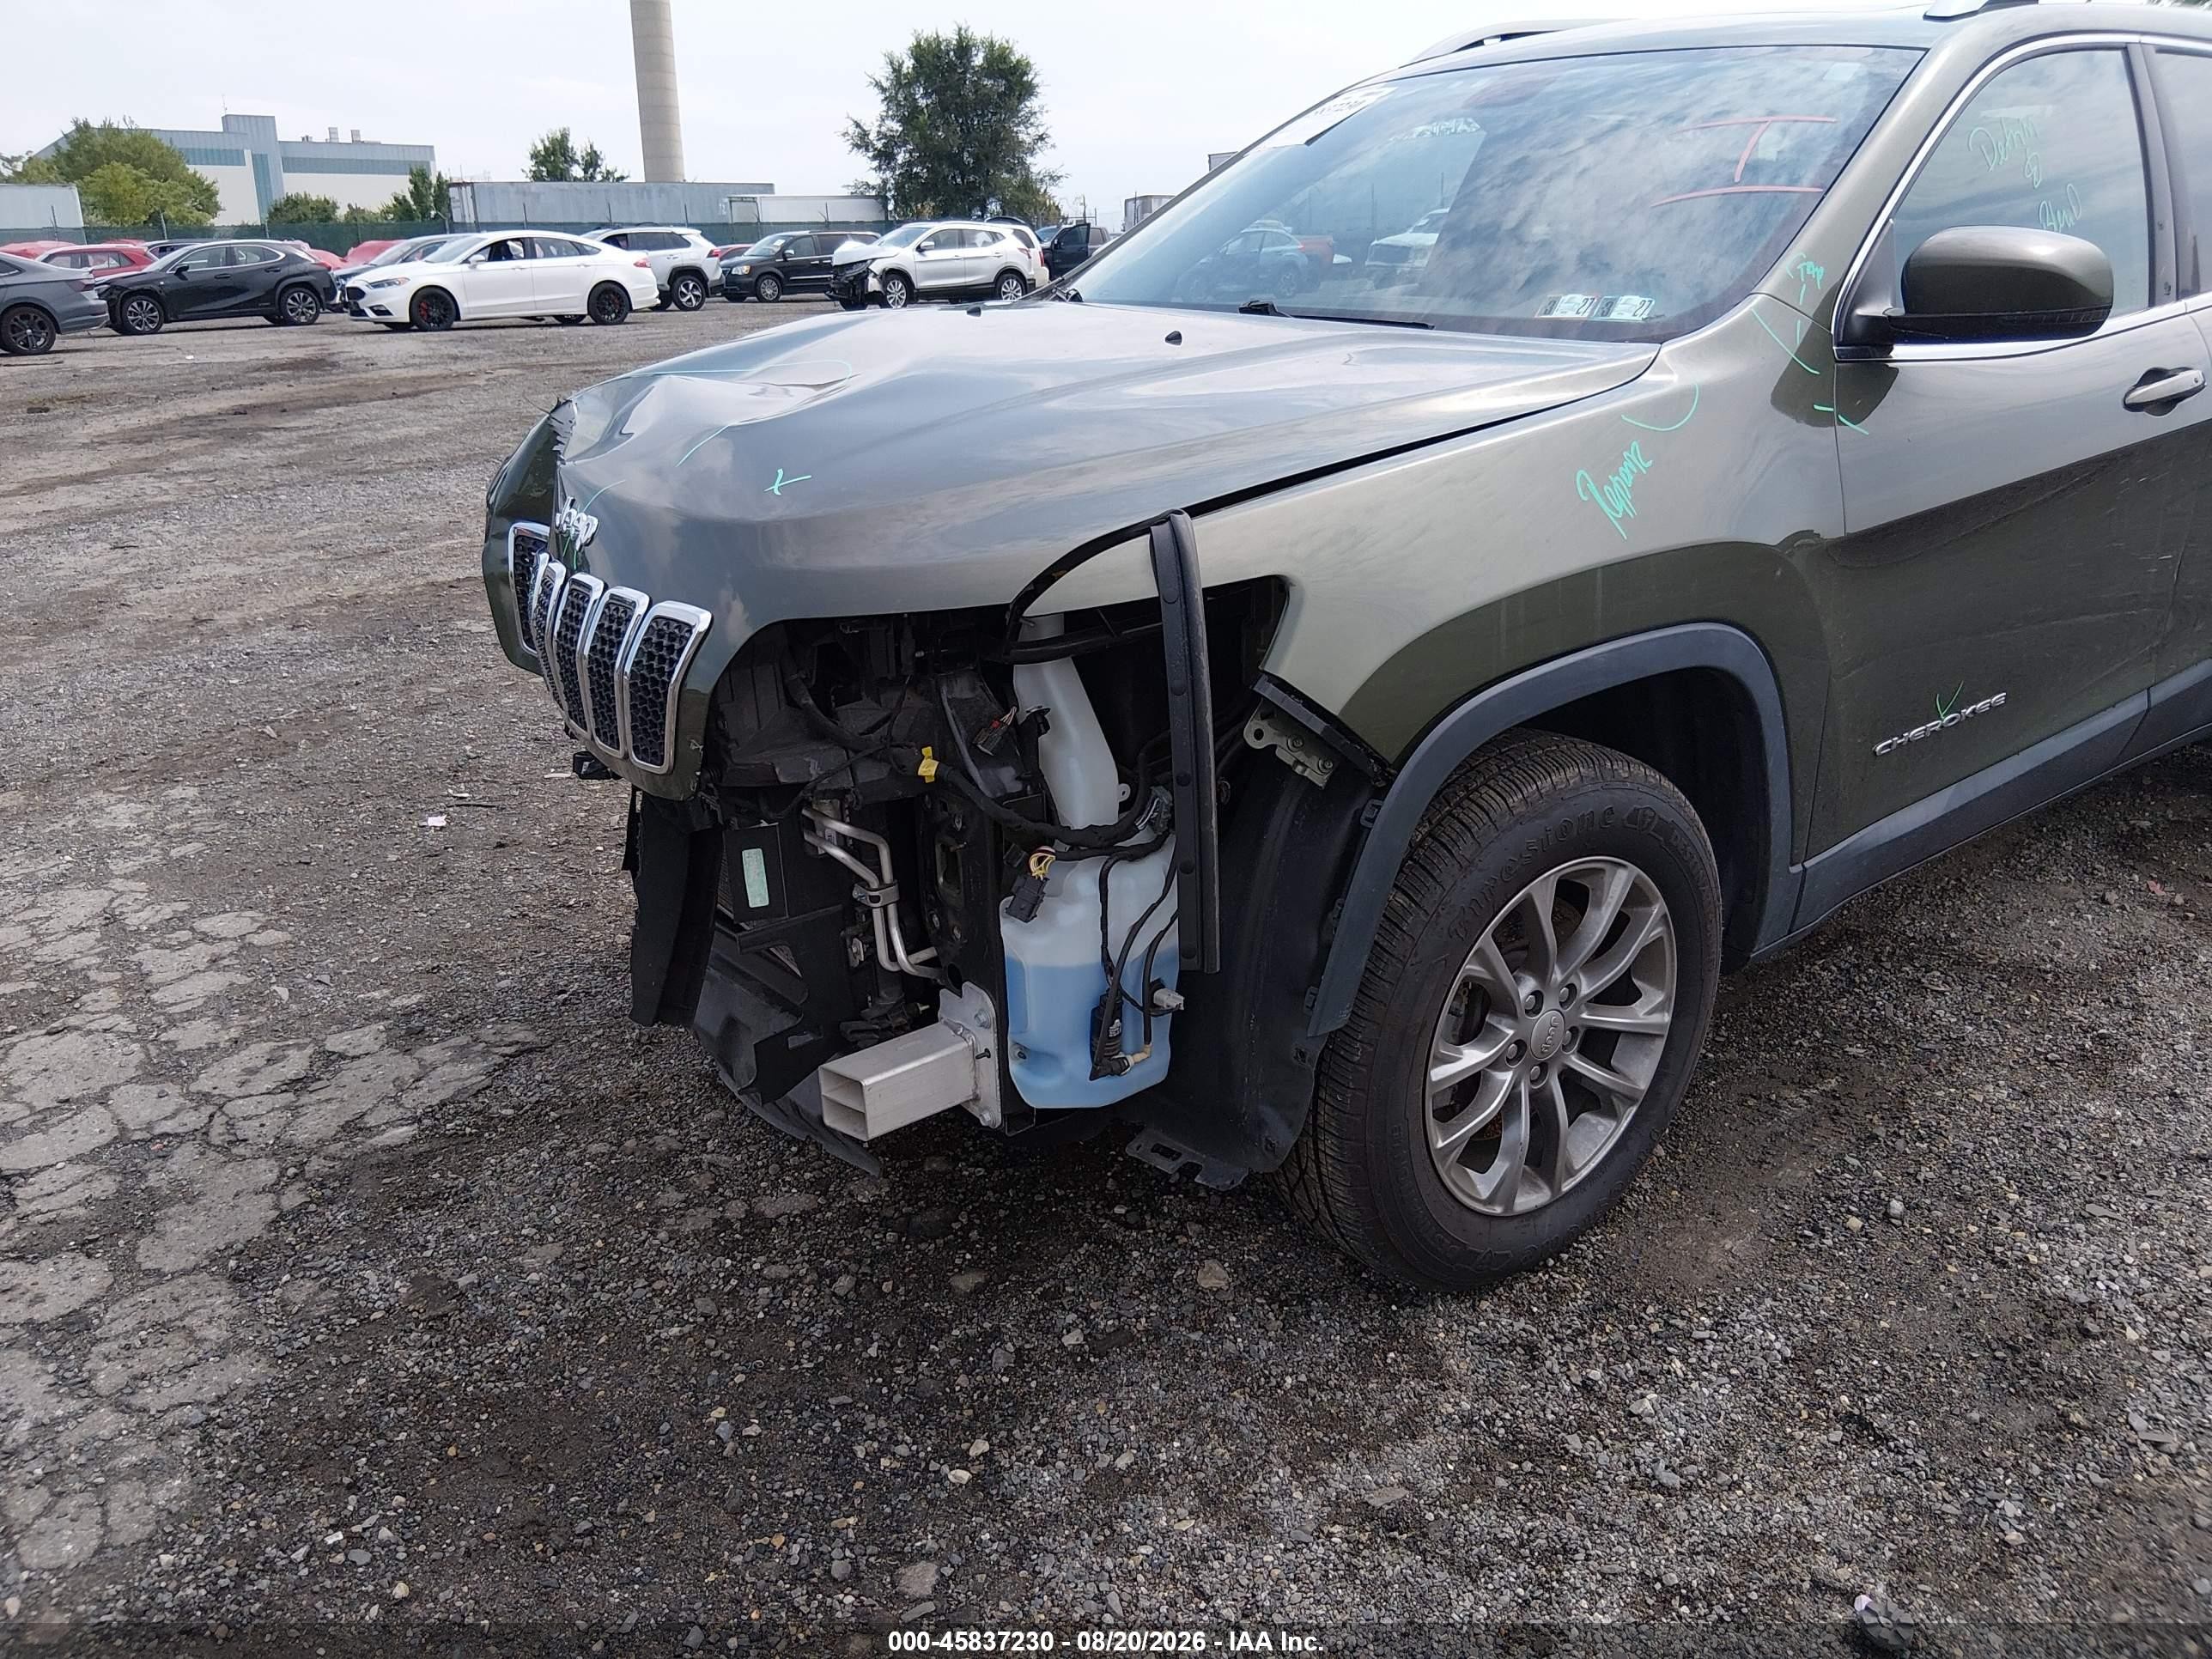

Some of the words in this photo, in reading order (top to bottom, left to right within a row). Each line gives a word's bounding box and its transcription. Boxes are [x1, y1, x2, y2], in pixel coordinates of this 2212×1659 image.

[1576, 297, 1595, 316] 27
[1632, 300, 1654, 317] 27
[555, 495, 599, 551] Jeep
[1875, 692, 2007, 757] CHEROKEE
